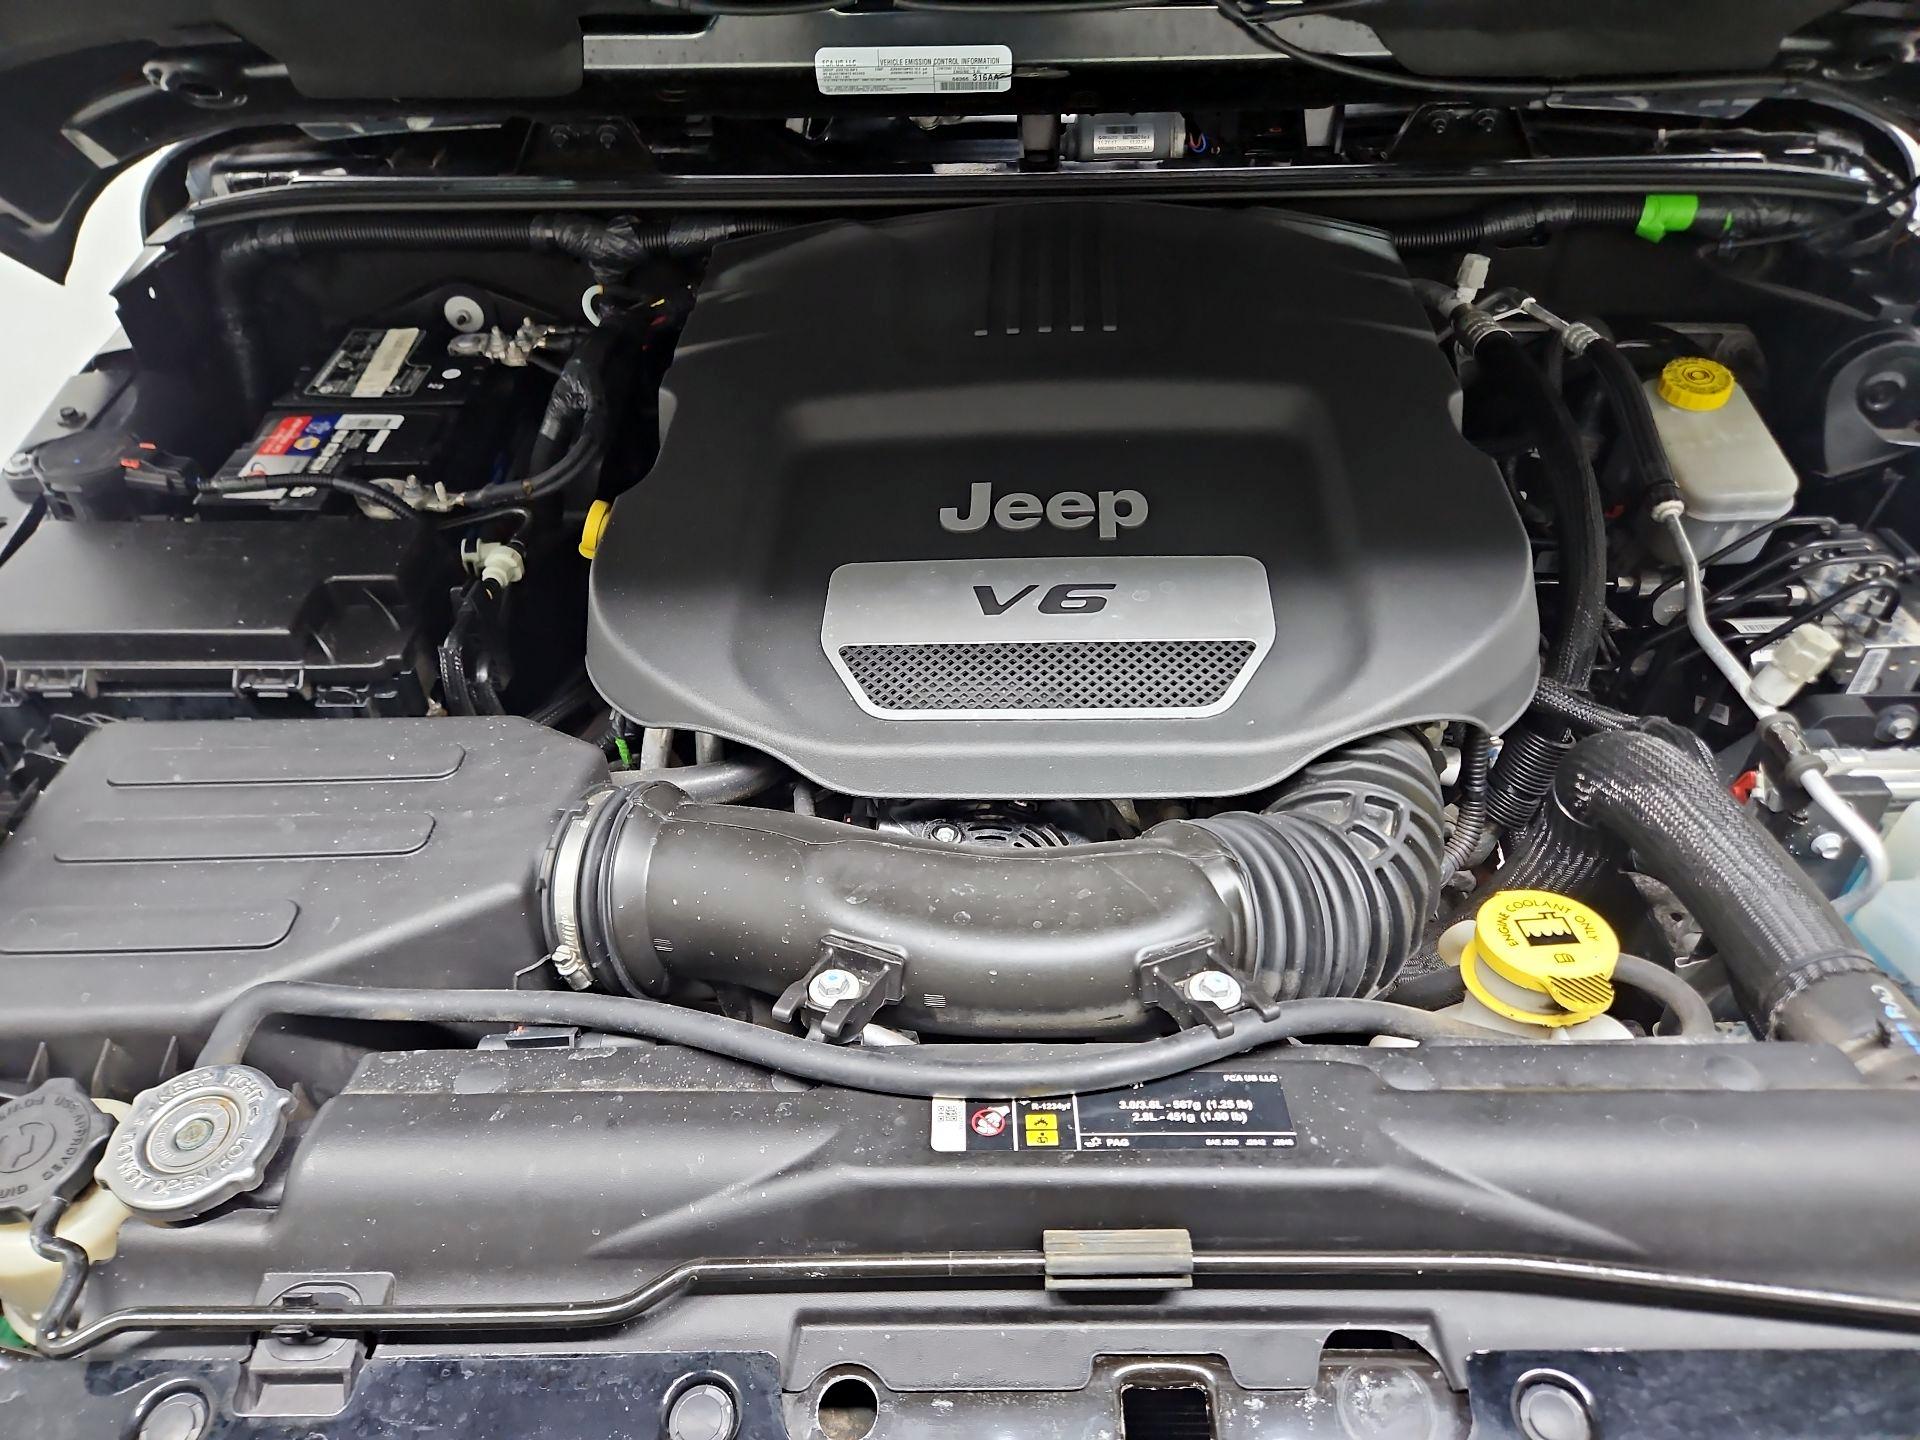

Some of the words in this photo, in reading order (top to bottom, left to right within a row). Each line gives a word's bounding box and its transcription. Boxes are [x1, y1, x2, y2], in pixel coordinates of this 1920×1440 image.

[880, 58, 903, 67] VEHICLE
[904, 58, 932, 66] EMISSION
[933, 57, 960, 66] CONTROL
[961, 57, 1000, 65] INFORMATION
[939, 481, 1149, 540] Jeep
[973, 583, 1117, 616] V6
[1506, 899, 1571, 914] COOLANT
[1496, 911, 1519, 947] ENGINE
[1574, 915, 1600, 942] ONLY
[158, 1072, 214, 1105] KEEP
[152, 1167, 211, 1195] OPEN
